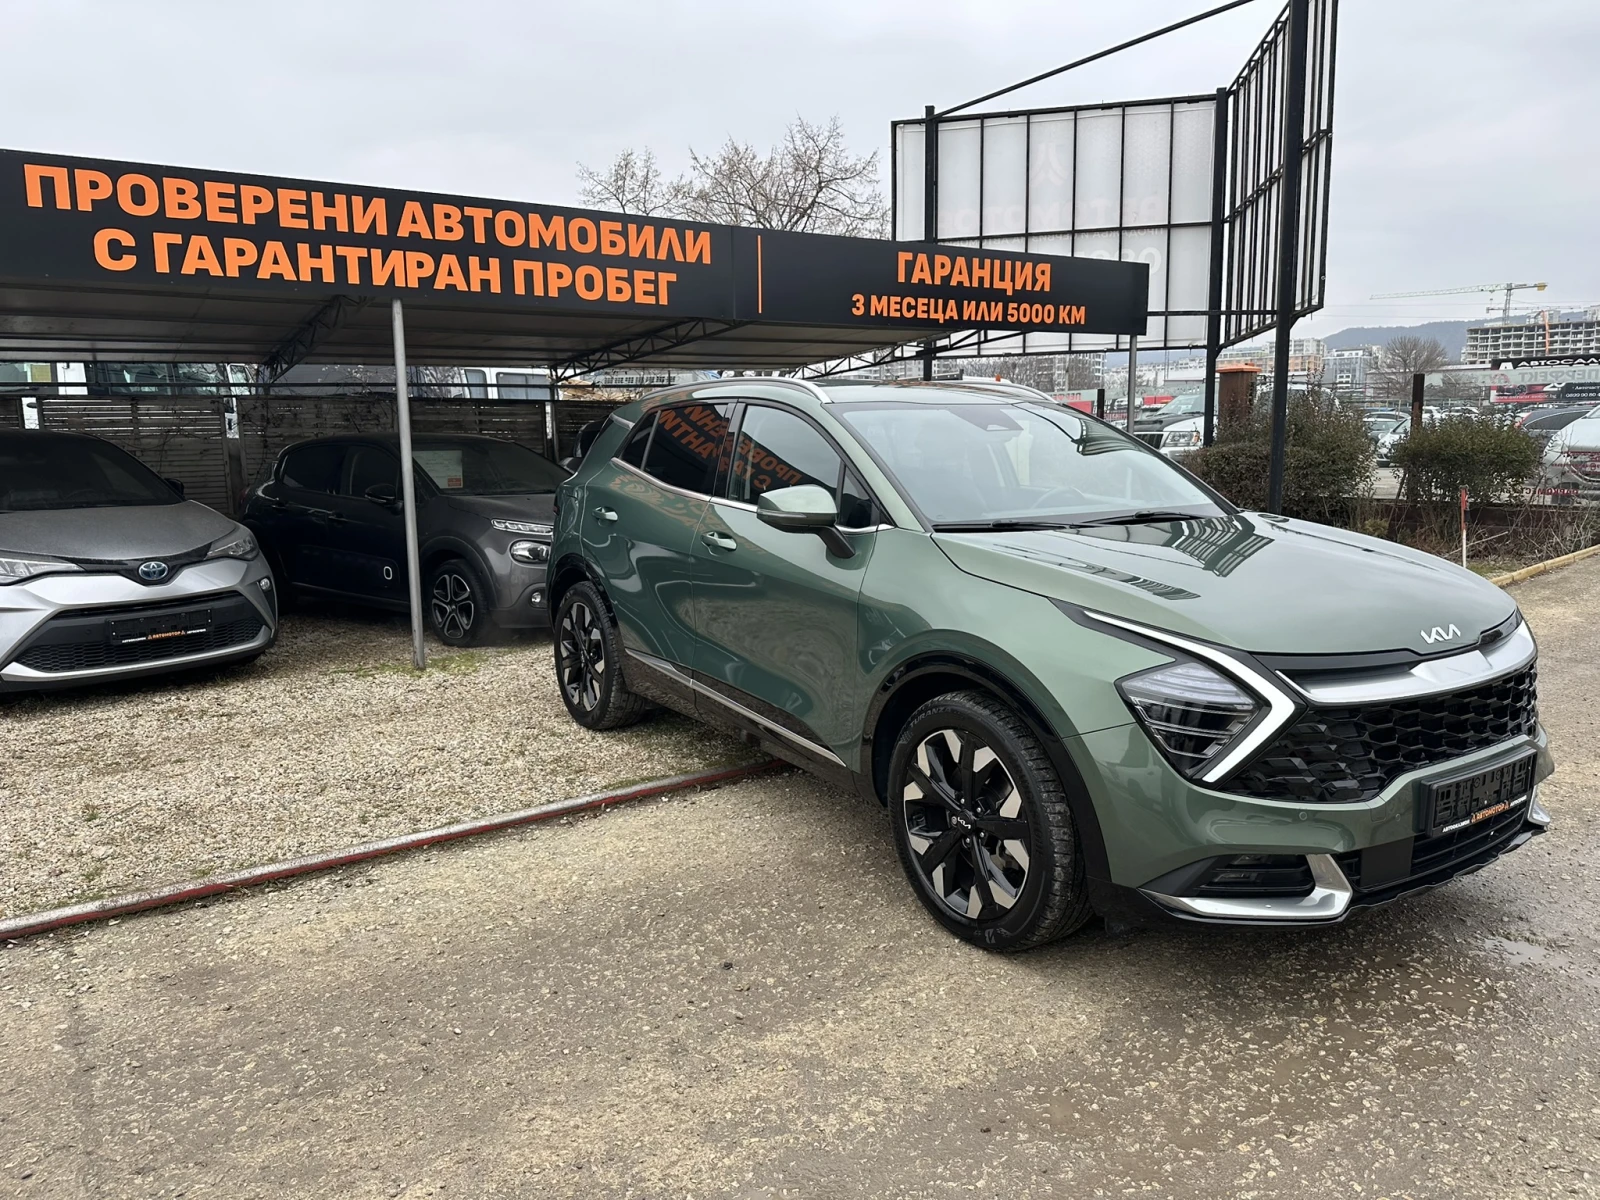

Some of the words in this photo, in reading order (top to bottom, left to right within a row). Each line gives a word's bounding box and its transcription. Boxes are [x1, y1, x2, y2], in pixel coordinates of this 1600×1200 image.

[24, 164, 388, 237] ПРОВЕРЕНИ
[397, 201, 711, 265] АВТОМОБИЛИ
[93, 228, 137, 271] С
[153, 232, 501, 294] ГАРАНТИРАН
[513, 259, 677, 306] ПРОБЕГ
[897, 251, 1051, 296] ГАРАНЦИЯ
[852, 293, 865, 315] 3
[870, 295, 958, 324] МЕСЕЦА
[963, 301, 1003, 322] ИЛИ
[1007, 302, 1055, 324] 5000
[1060, 305, 1086, 324] КМ
[1517, 357, 1600, 366] АВТОСАЛ
